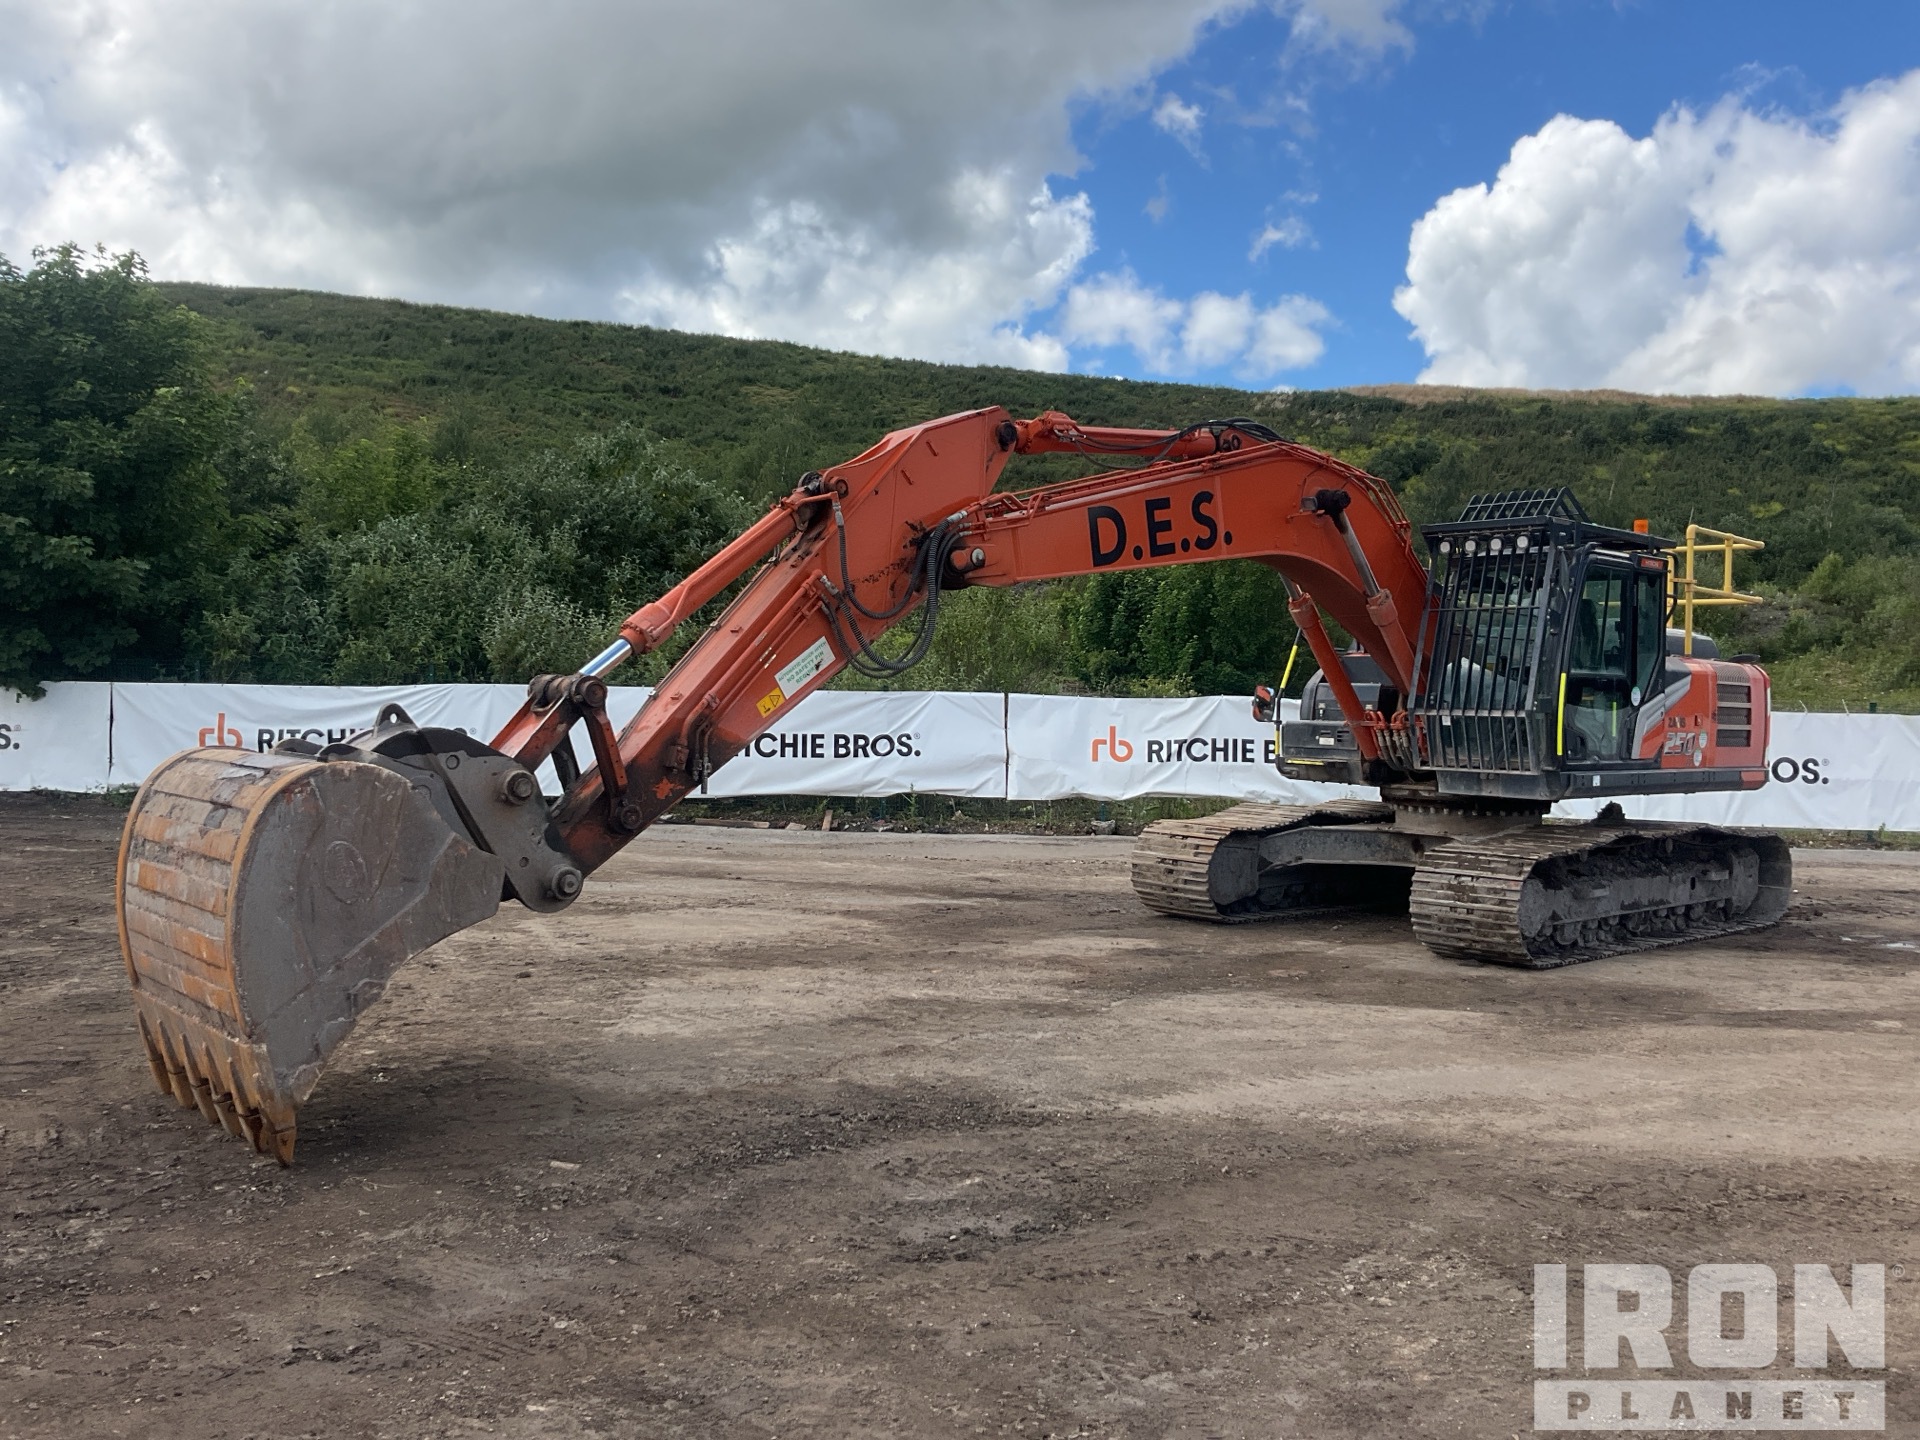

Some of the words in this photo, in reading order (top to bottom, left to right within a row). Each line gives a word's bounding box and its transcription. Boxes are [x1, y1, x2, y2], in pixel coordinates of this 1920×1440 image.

[1087, 490, 1233, 567] D.E.S.
[794, 658, 815, 677] SAFETY
[1147, 737, 1255, 763] RITCHIE
